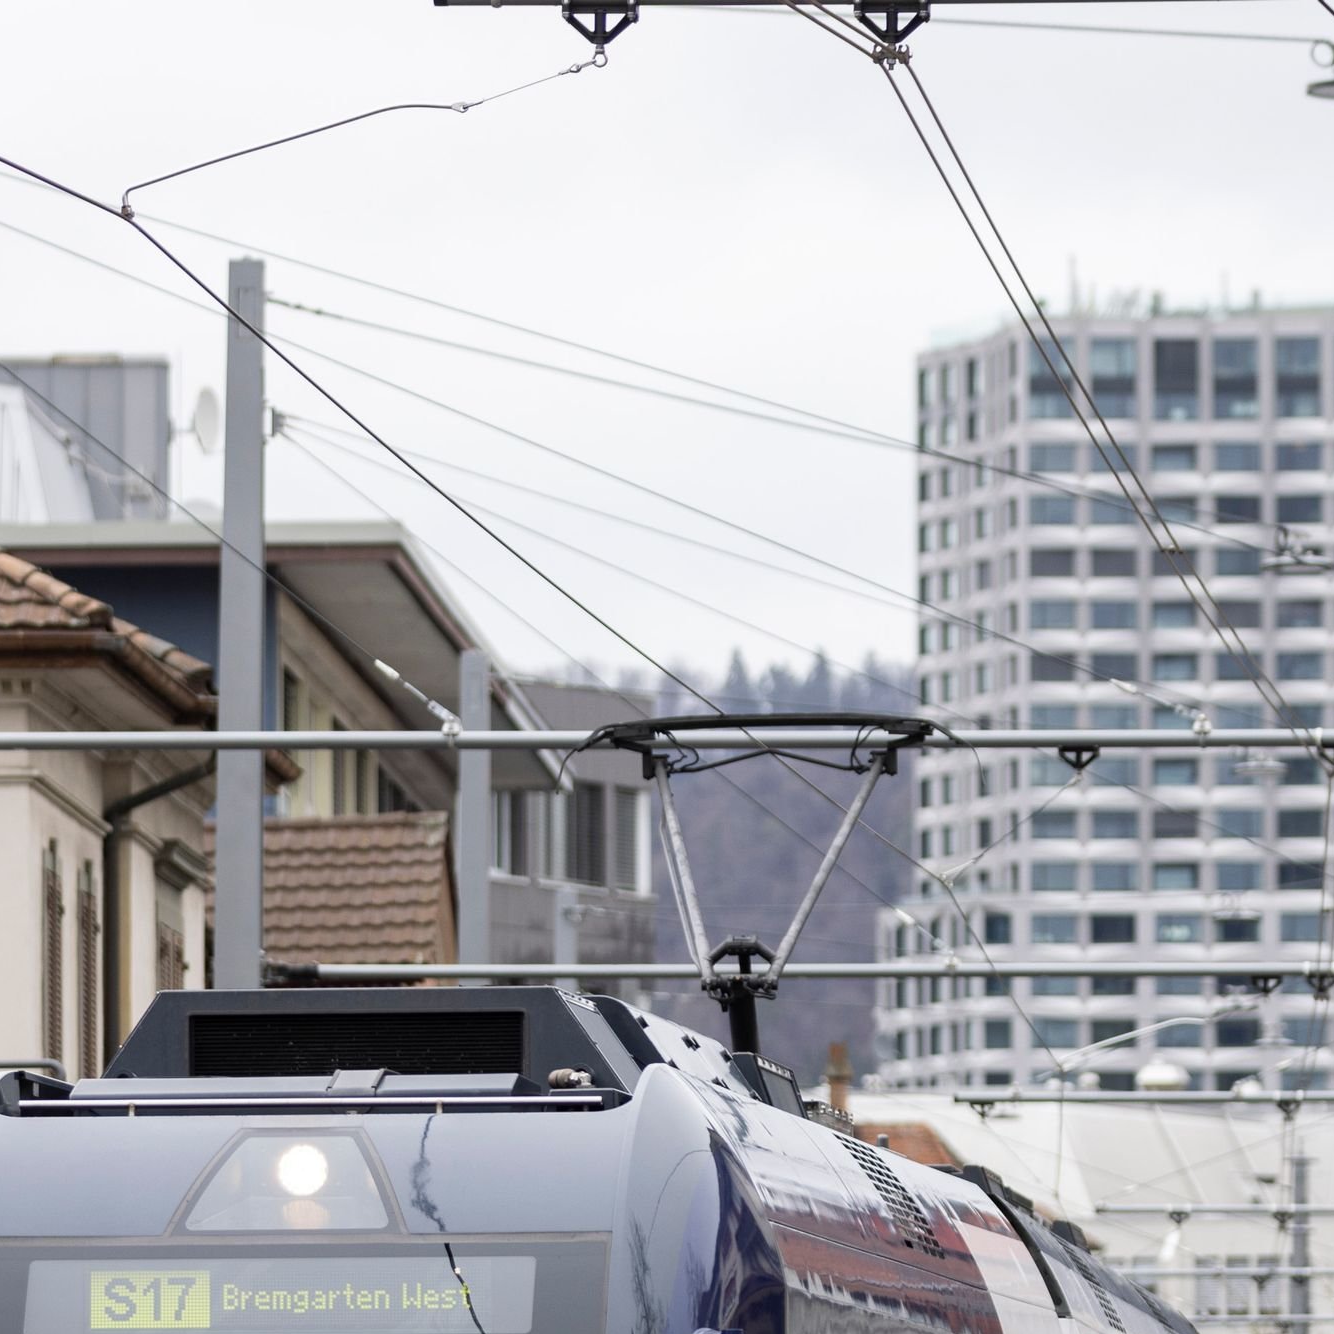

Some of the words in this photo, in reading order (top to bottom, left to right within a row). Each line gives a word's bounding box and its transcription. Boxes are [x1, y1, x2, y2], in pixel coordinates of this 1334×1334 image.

[103, 1277, 196, 1322] S17
[222, 1282, 390, 1314] Bremgarten
[402, 1282, 471, 1310] West
